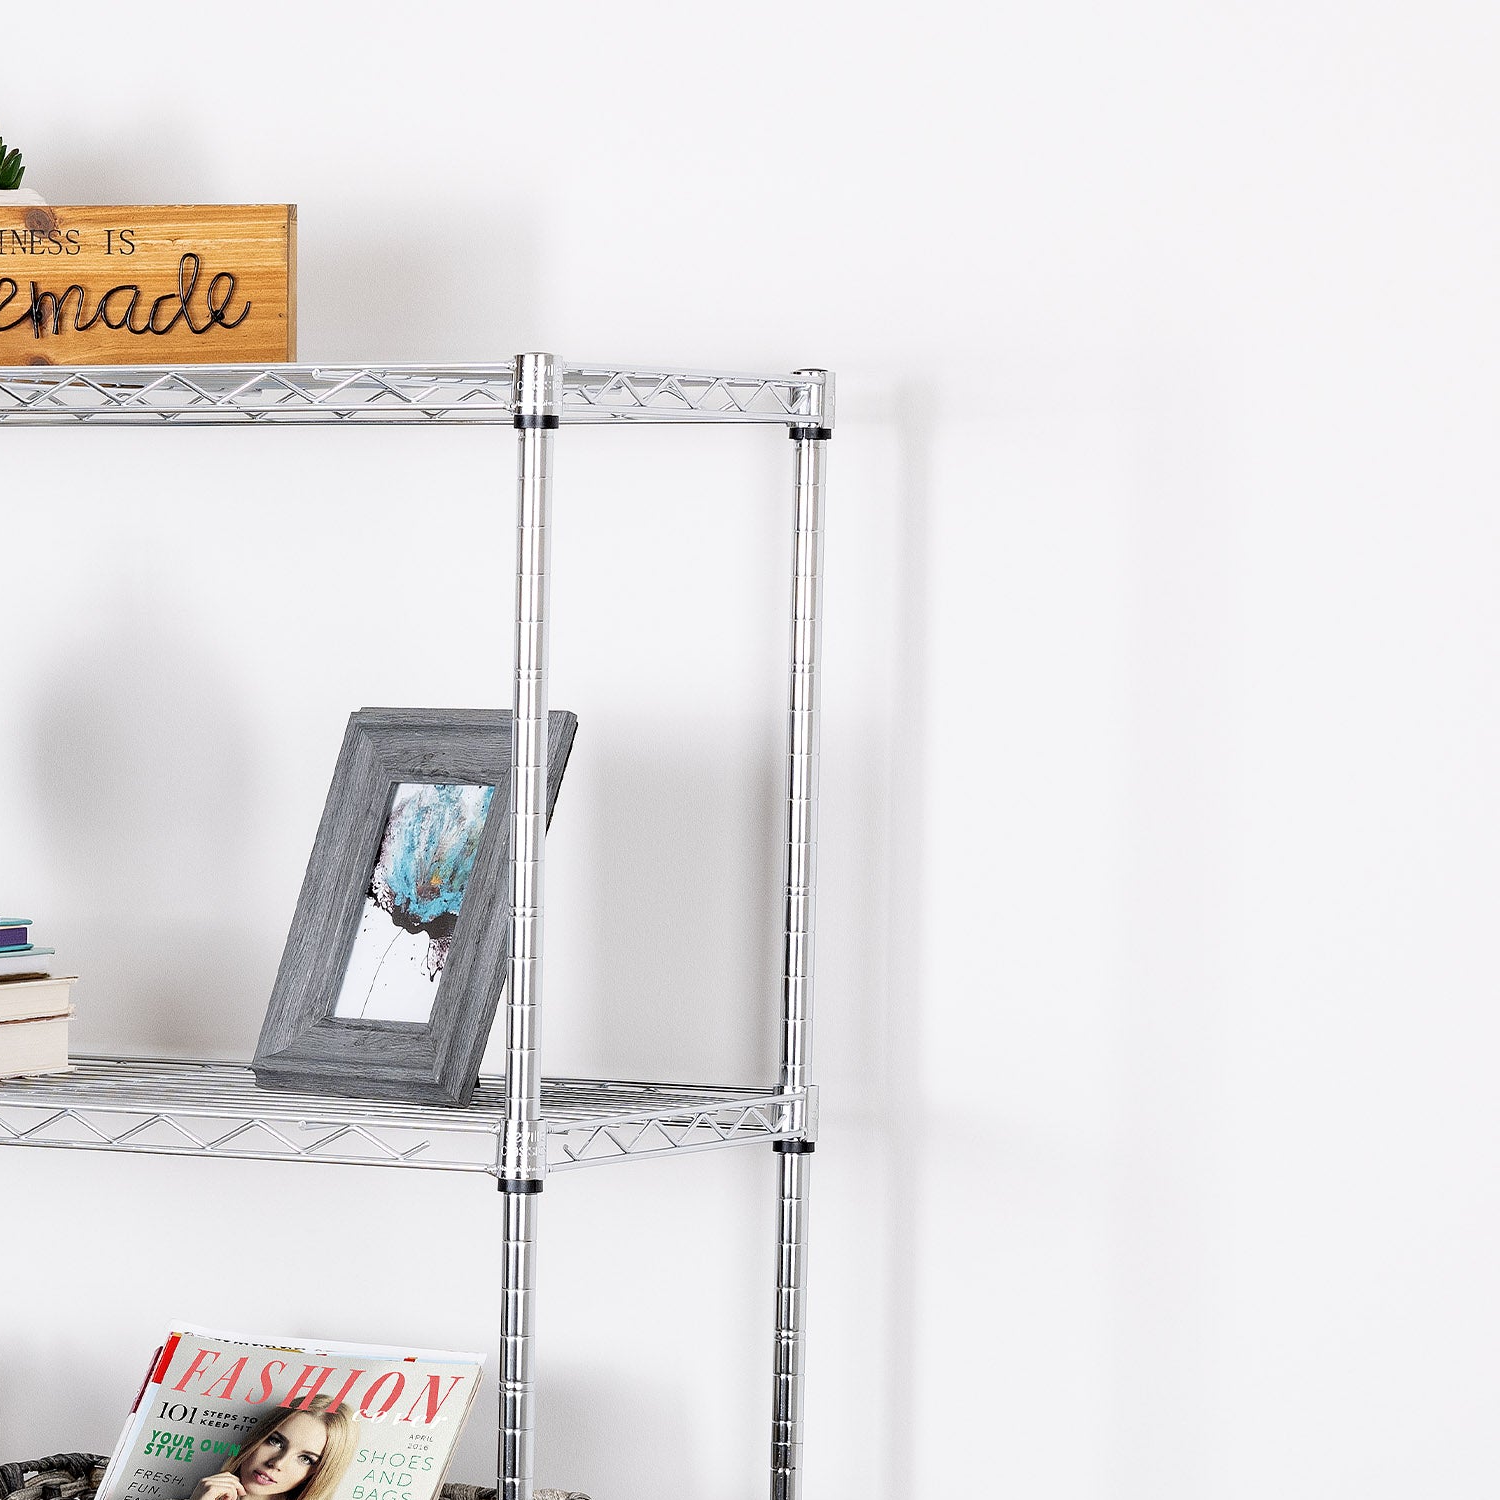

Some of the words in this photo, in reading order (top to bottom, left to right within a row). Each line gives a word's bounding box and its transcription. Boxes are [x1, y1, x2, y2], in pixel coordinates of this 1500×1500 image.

[103, 228, 137, 256] IS
[171, 1348, 465, 1424] FASHION
[156, 1401, 198, 1425] 101
[202, 1409, 238, 1421] STEPS
[242, 1415, 258, 1424] TO
[199, 1418, 230, 1429] KEEP
[233, 1424, 253, 1433] FIT
[151, 1429, 195, 1449] YOUR
[200, 1439, 242, 1457] OWN
[409, 1434, 434, 1443] APRIL
[143, 1442, 195, 1463] STYLE
[356, 1449, 434, 1472] SHOES
[133, 1468, 186, 1487] FRESH,
[362, 1469, 413, 1487] AND
[127, 1481, 162, 1498] FUN,
